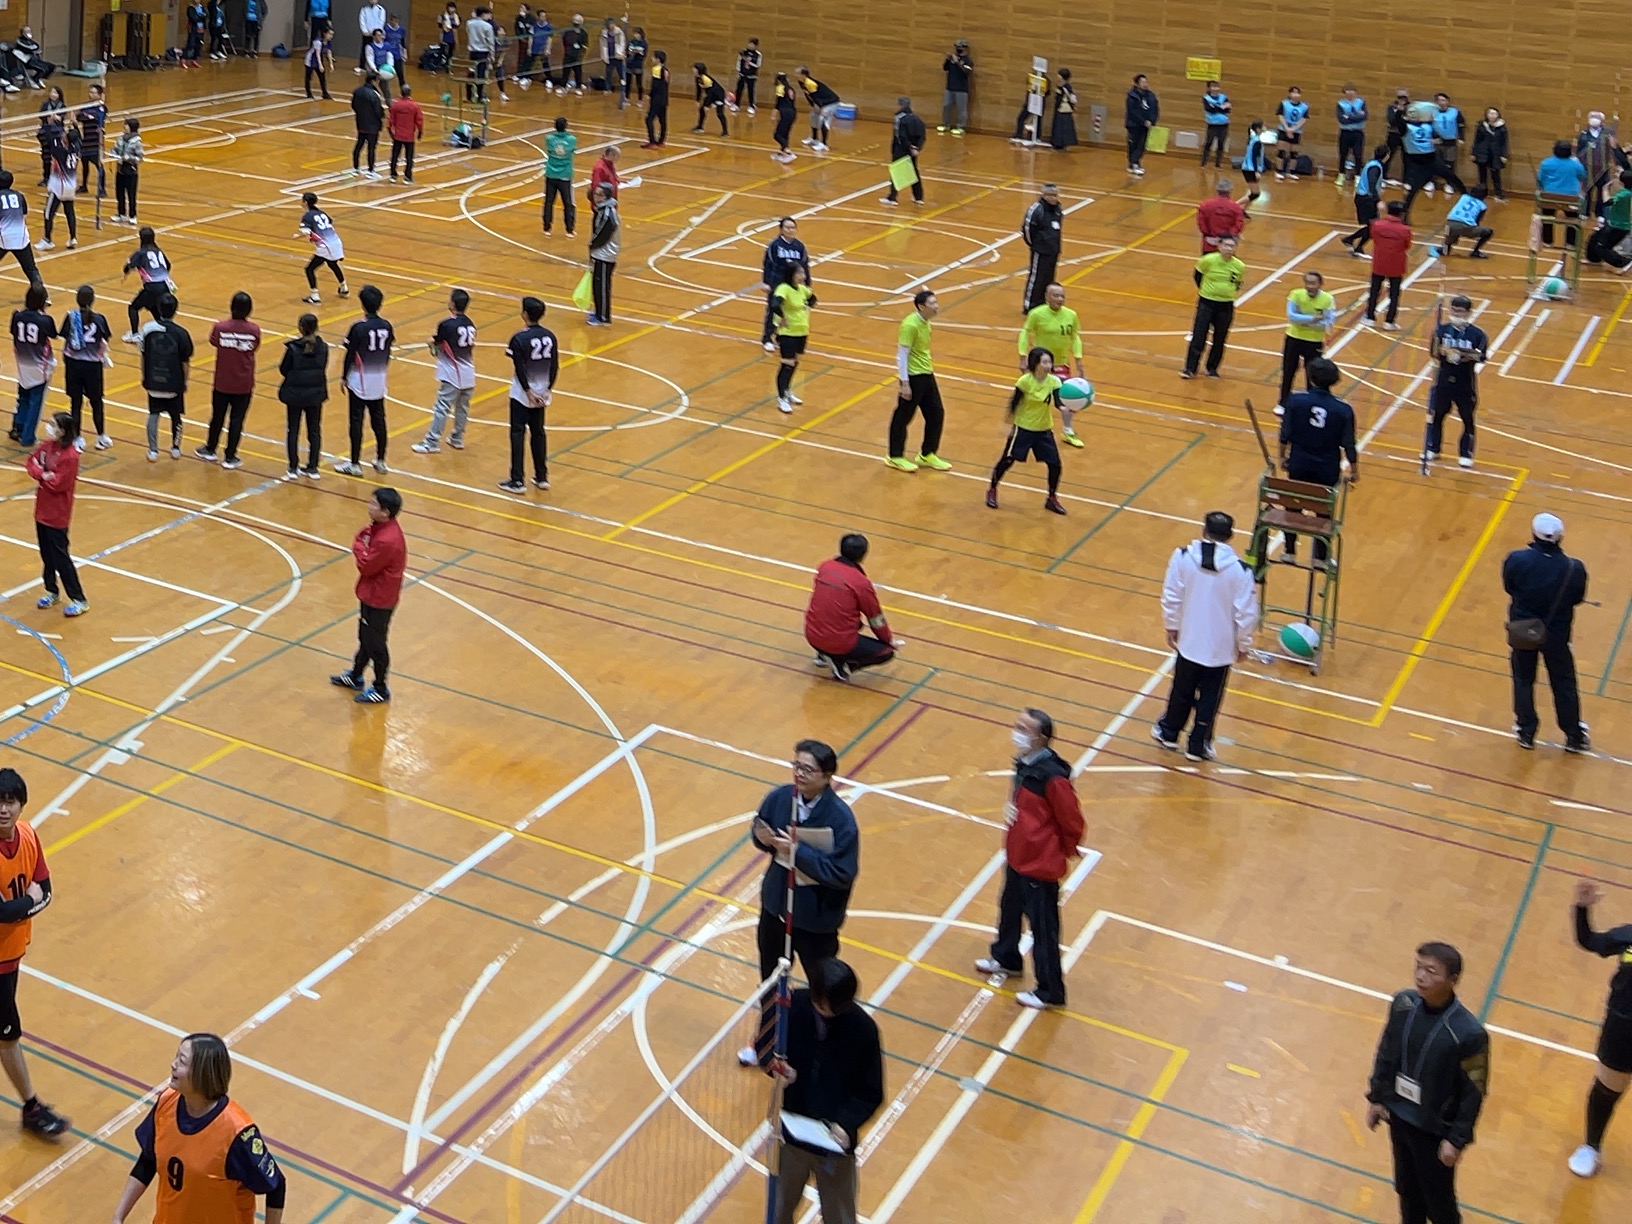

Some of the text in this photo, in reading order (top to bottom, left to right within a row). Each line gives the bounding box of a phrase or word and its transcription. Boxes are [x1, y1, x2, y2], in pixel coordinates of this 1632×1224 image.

[0, 193, 20, 210] 18
[313, 213, 332, 230] 32
[17, 321, 40, 344] 19
[369, 329, 389, 351] 17
[1060, 324, 1073, 336] 10
[530, 336, 553, 360] 22
[1309, 406, 1327, 428] 3
[7, 873, 27, 900] 10
[167, 1157, 184, 1191] 9
